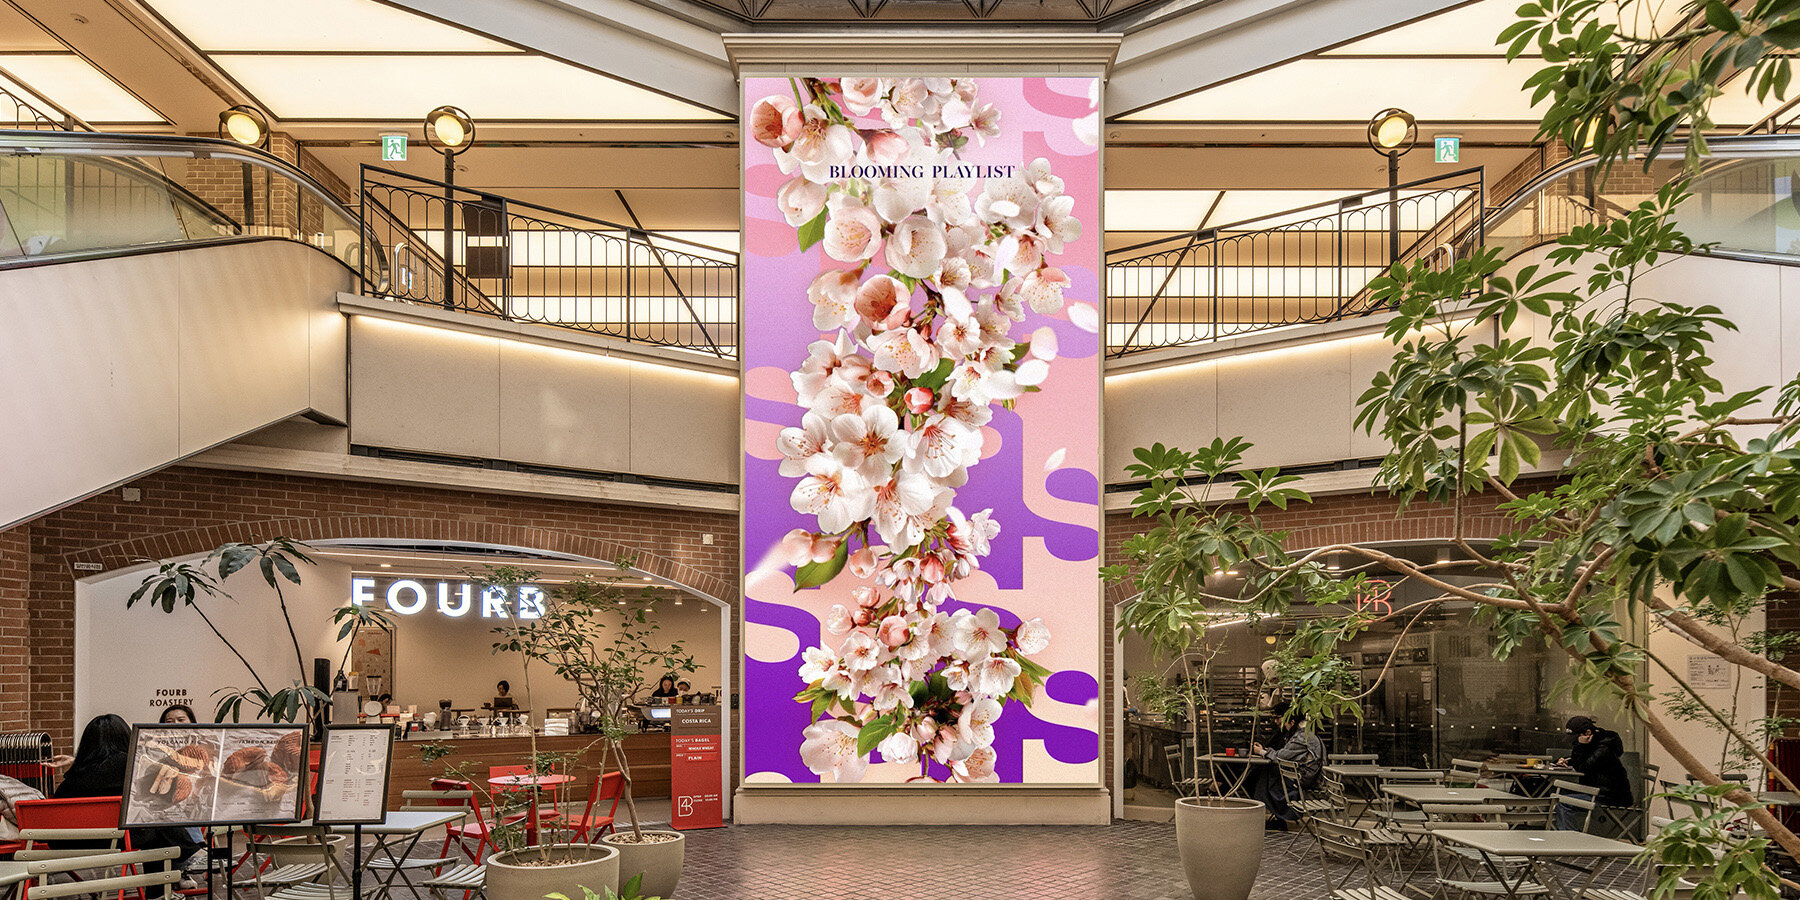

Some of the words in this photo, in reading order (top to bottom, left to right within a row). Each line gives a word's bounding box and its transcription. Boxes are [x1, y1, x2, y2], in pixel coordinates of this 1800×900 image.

[829, 165, 924, 179] BLOOMING
[932, 165, 1016, 179] PLAYLIST
[352, 578, 546, 619] FOURB
[149, 699, 194, 707] ROASTERY
